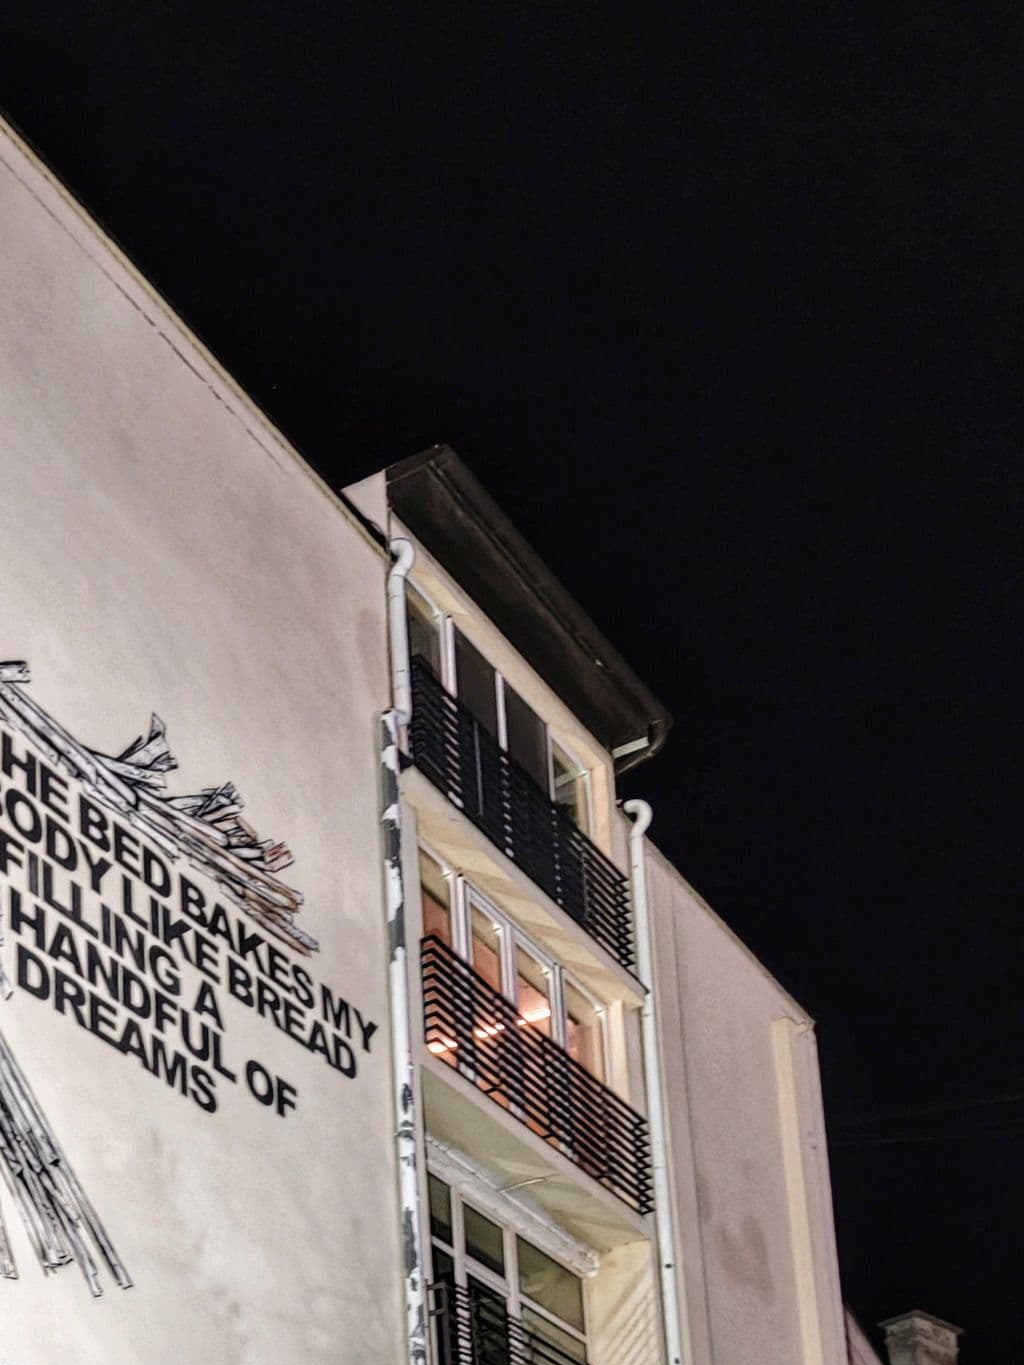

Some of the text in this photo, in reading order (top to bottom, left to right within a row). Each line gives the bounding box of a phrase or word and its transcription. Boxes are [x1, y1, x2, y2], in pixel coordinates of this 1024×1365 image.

[10, 886, 297, 1118] HANDFUL OF
[79, 794, 172, 898] BED
[180, 875, 312, 1010] BAKES
[321, 984, 378, 1053] MY
[123, 875, 220, 984] LIKE
[228, 961, 356, 1079] BREAD
[195, 981, 225, 1031] A
[17, 942, 216, 1113] DREAMS
